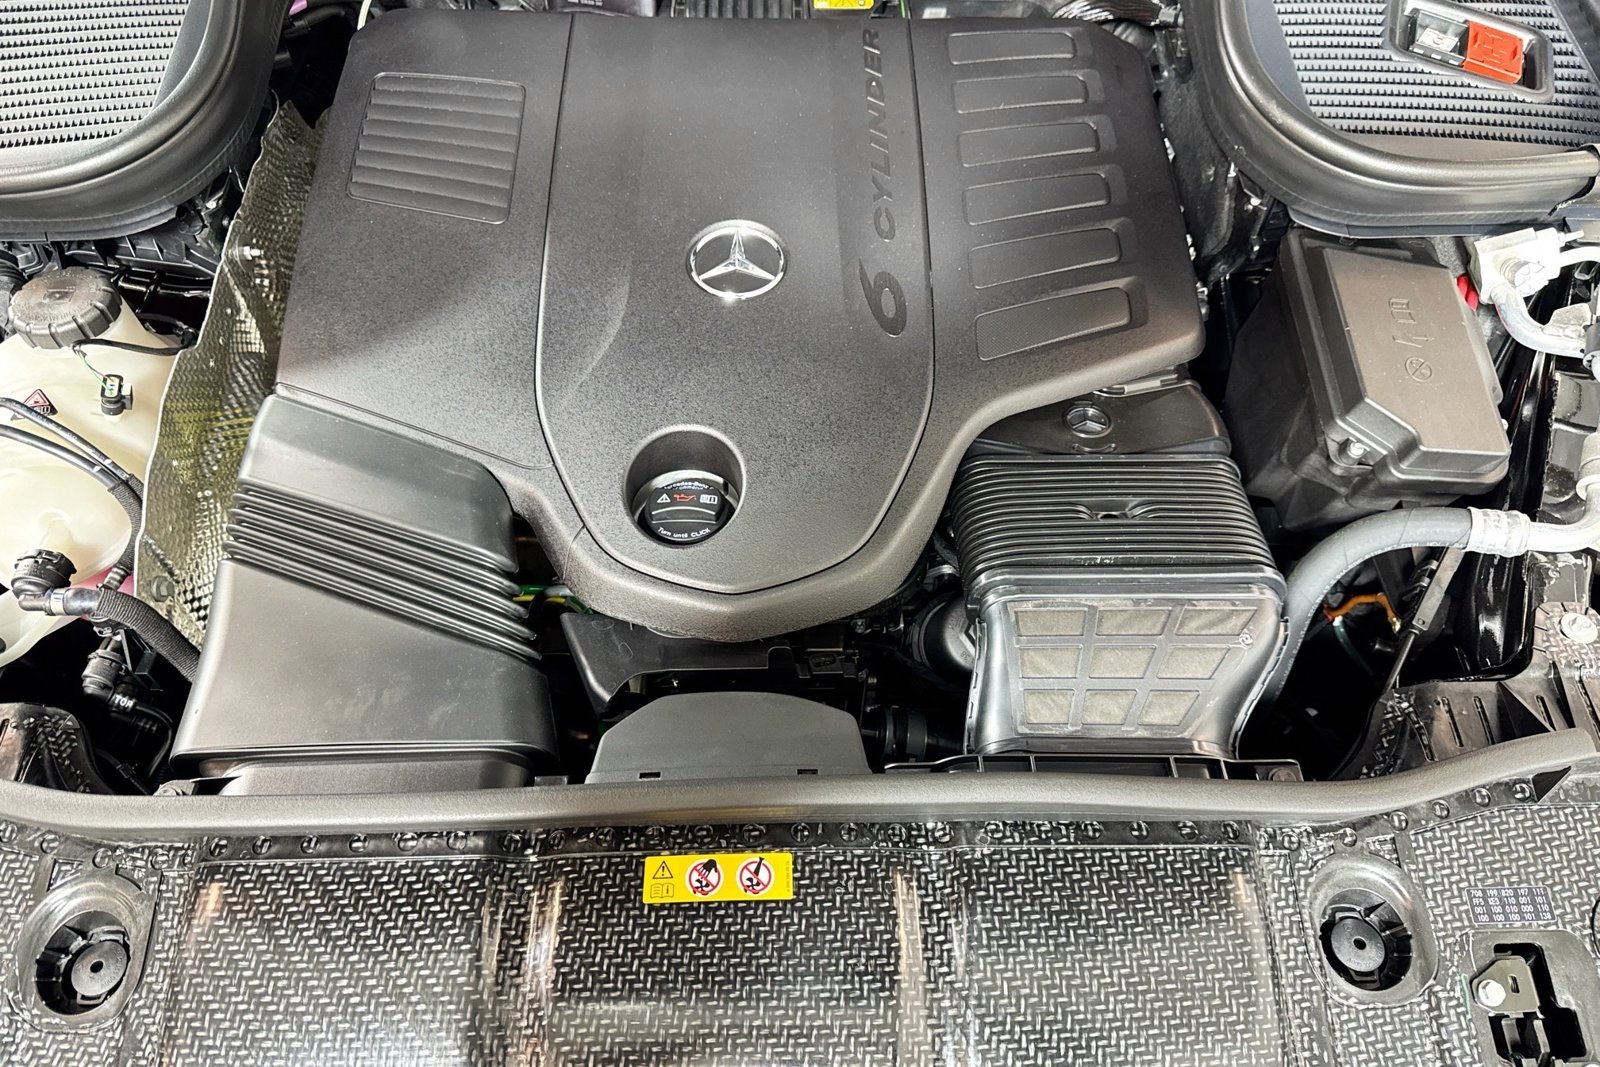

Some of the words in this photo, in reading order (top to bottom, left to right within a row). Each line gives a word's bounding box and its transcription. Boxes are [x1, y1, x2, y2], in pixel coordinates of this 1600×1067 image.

[862, 28, 896, 242] CYLINDER
[858, 257, 908, 338] 6
[658, 527, 672, 536] Turn
[691, 528, 711, 537] CLICK
[114, 694, 134, 708] TOP
[1474, 906, 1487, 914] 001
[1505, 905, 1518, 913] 010
[1477, 914, 1489, 922] 100
[1508, 913, 1520, 921] 100
